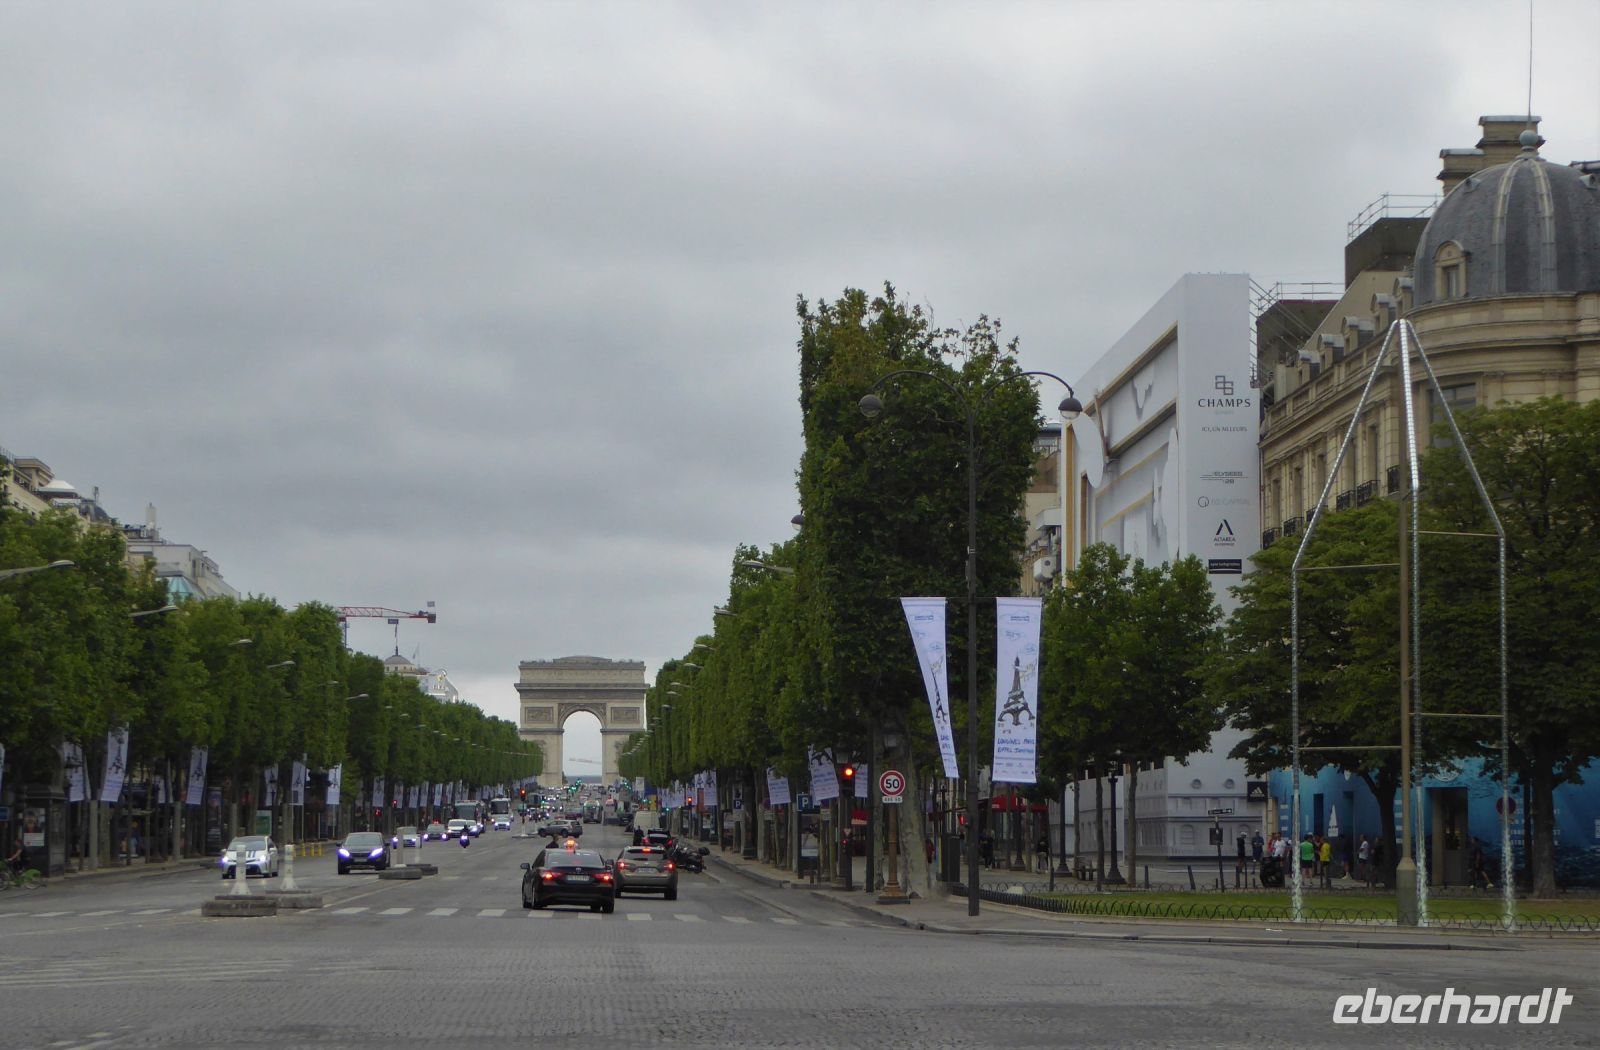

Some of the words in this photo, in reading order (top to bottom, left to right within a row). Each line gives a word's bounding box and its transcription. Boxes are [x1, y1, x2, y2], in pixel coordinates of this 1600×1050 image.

[1198, 398, 1251, 408] CHAMPS
[886, 778, 900, 789] 50
[801, 797, 809, 807] P
